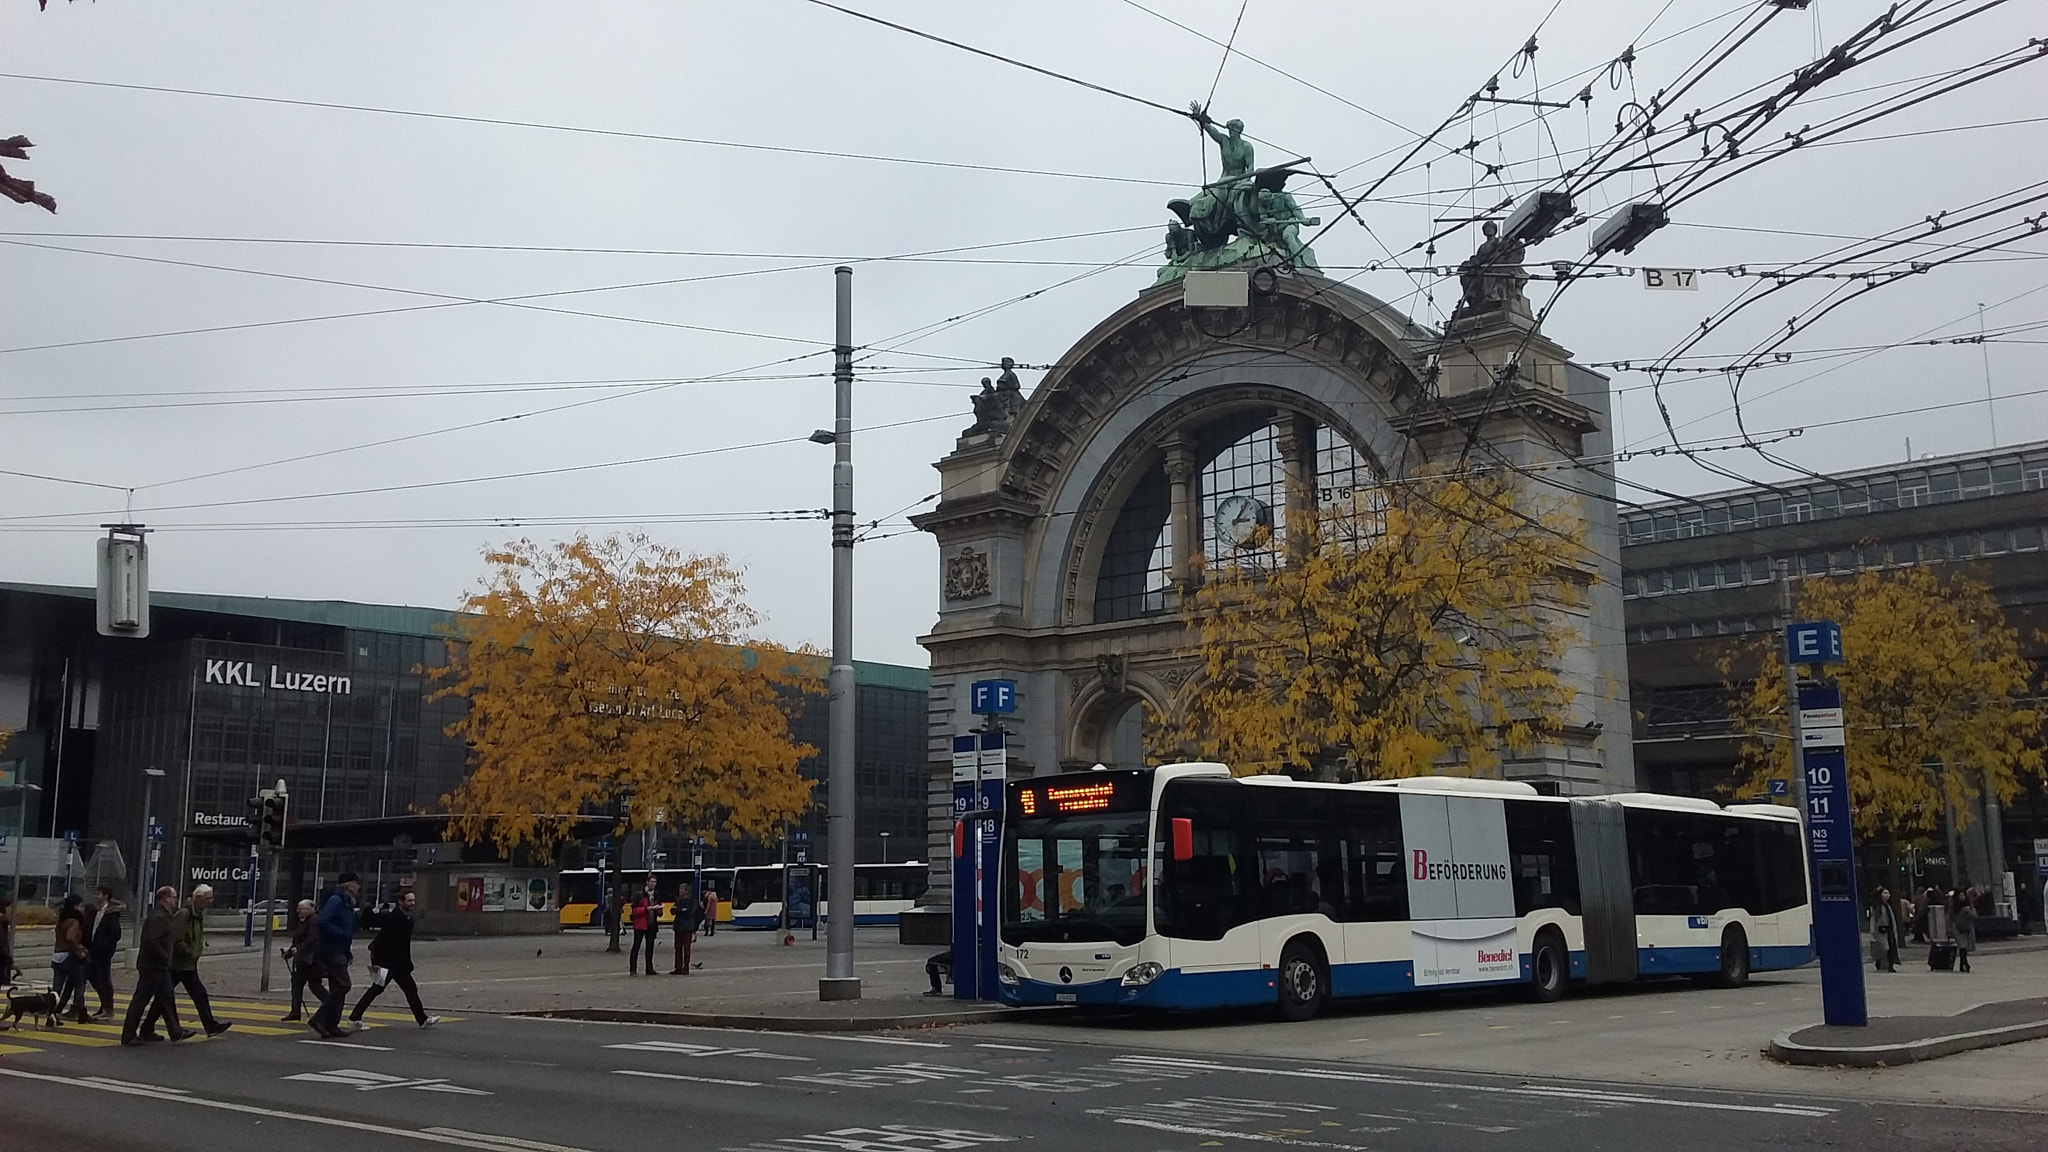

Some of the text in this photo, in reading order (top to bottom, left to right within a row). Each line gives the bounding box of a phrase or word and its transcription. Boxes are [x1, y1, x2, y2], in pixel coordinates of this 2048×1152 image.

[1646, 269, 1694, 287] B 17
[1322, 487, 1351, 502] B 16
[1797, 629, 1820, 656] E
[1830, 629, 1840, 656] E
[205, 658, 351, 695] KKL Luzern
[977, 686, 988, 708] F
[998, 686, 1009, 707] F
[1807, 767, 1831, 785] 10
[1774, 781, 1785, 793] Z
[954, 797, 966, 811] 19
[982, 796, 989, 810] 9
[1810, 797, 1829, 814] 11
[982, 819, 995, 833] 18
[1812, 829, 1828, 839] N3
[1412, 849, 1507, 881] BEFÖRDERUNG
[191, 867, 228, 880] World
[1016, 949, 1029, 959] 172
[1477, 948, 1513, 963] Benedict
